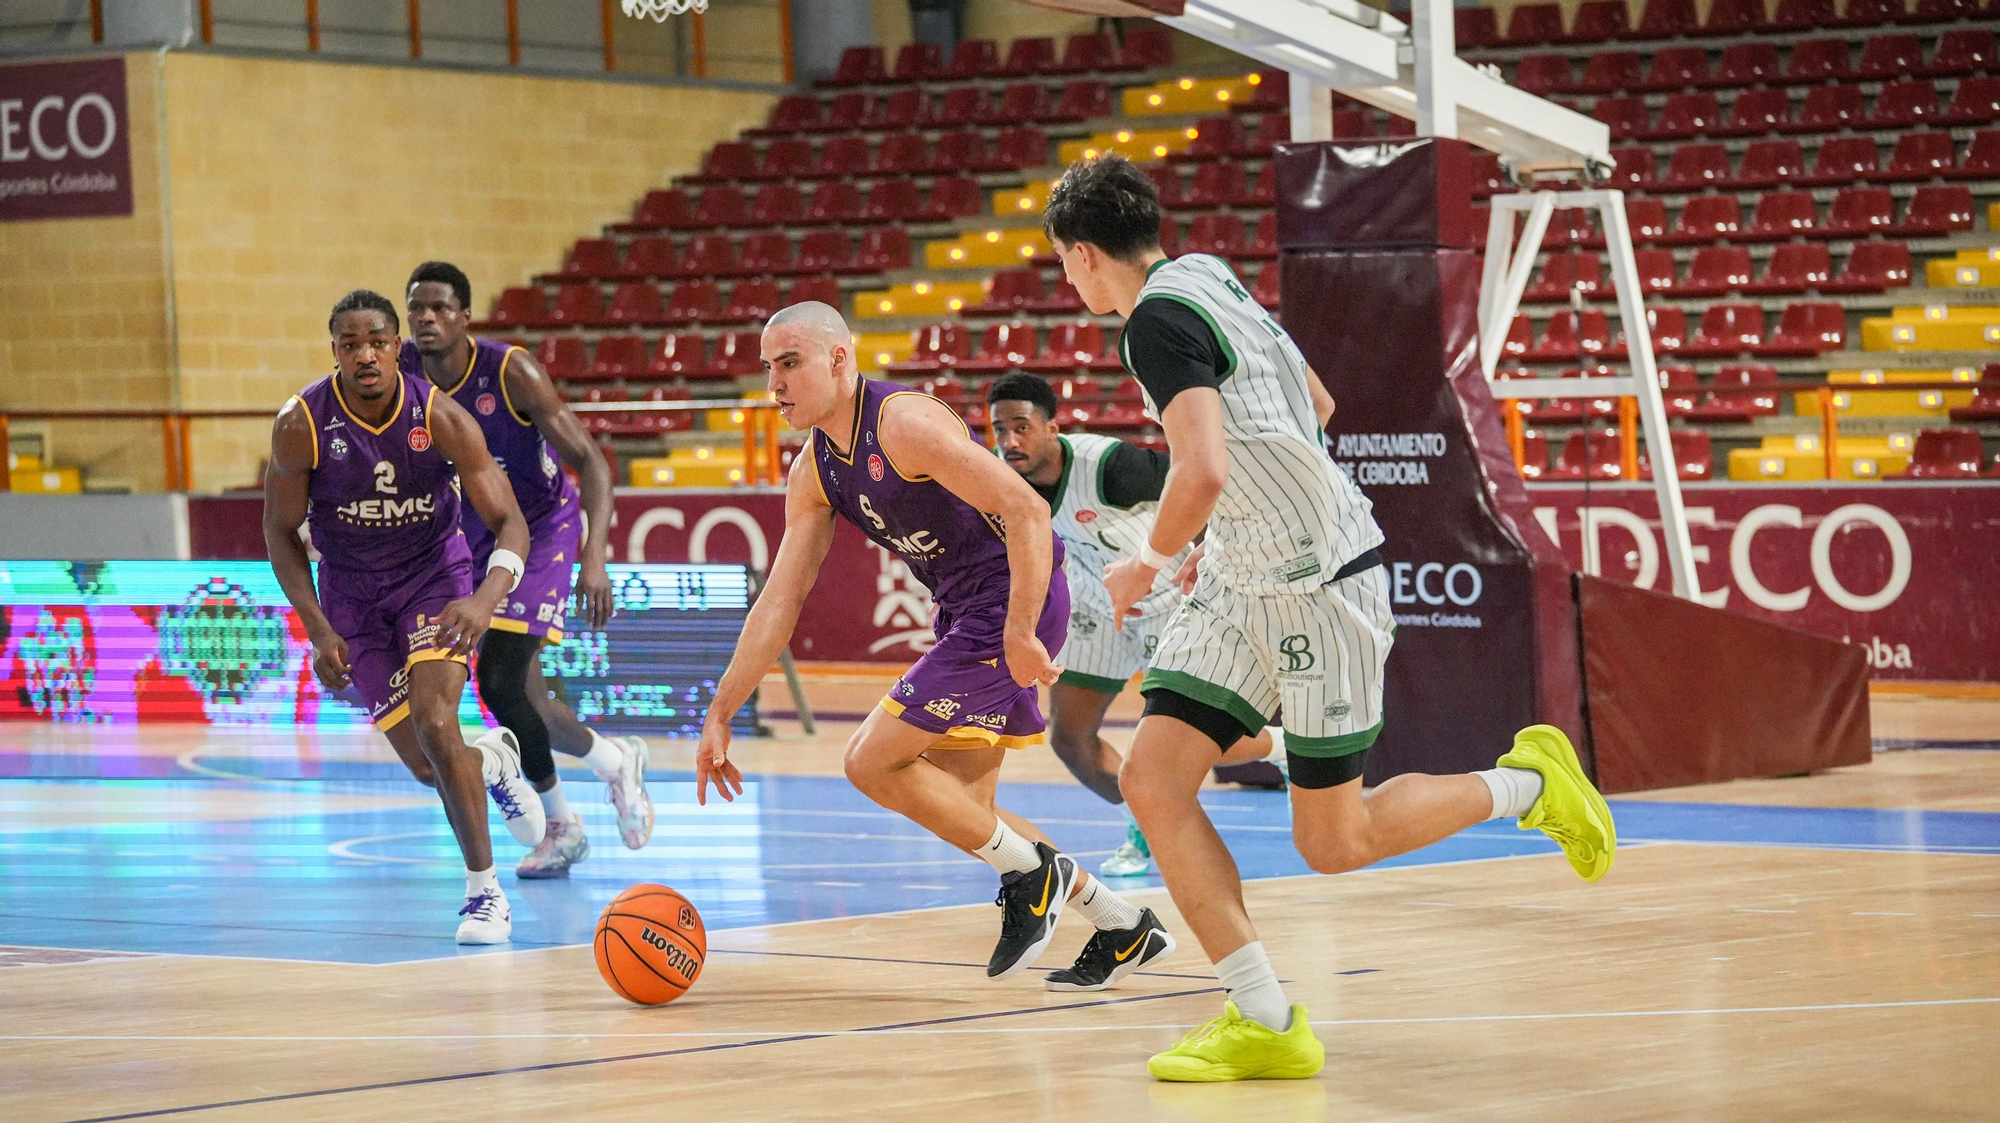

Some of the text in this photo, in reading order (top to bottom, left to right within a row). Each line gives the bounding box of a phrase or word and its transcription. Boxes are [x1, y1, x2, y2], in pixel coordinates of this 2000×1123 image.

[1336, 432, 1447, 457] AYUNTAMIENTO
[373, 460, 399, 494] 2
[858, 493, 886, 530] 9
[1386, 561, 1483, 606] ECO
[641, 926, 699, 981] Wilson
